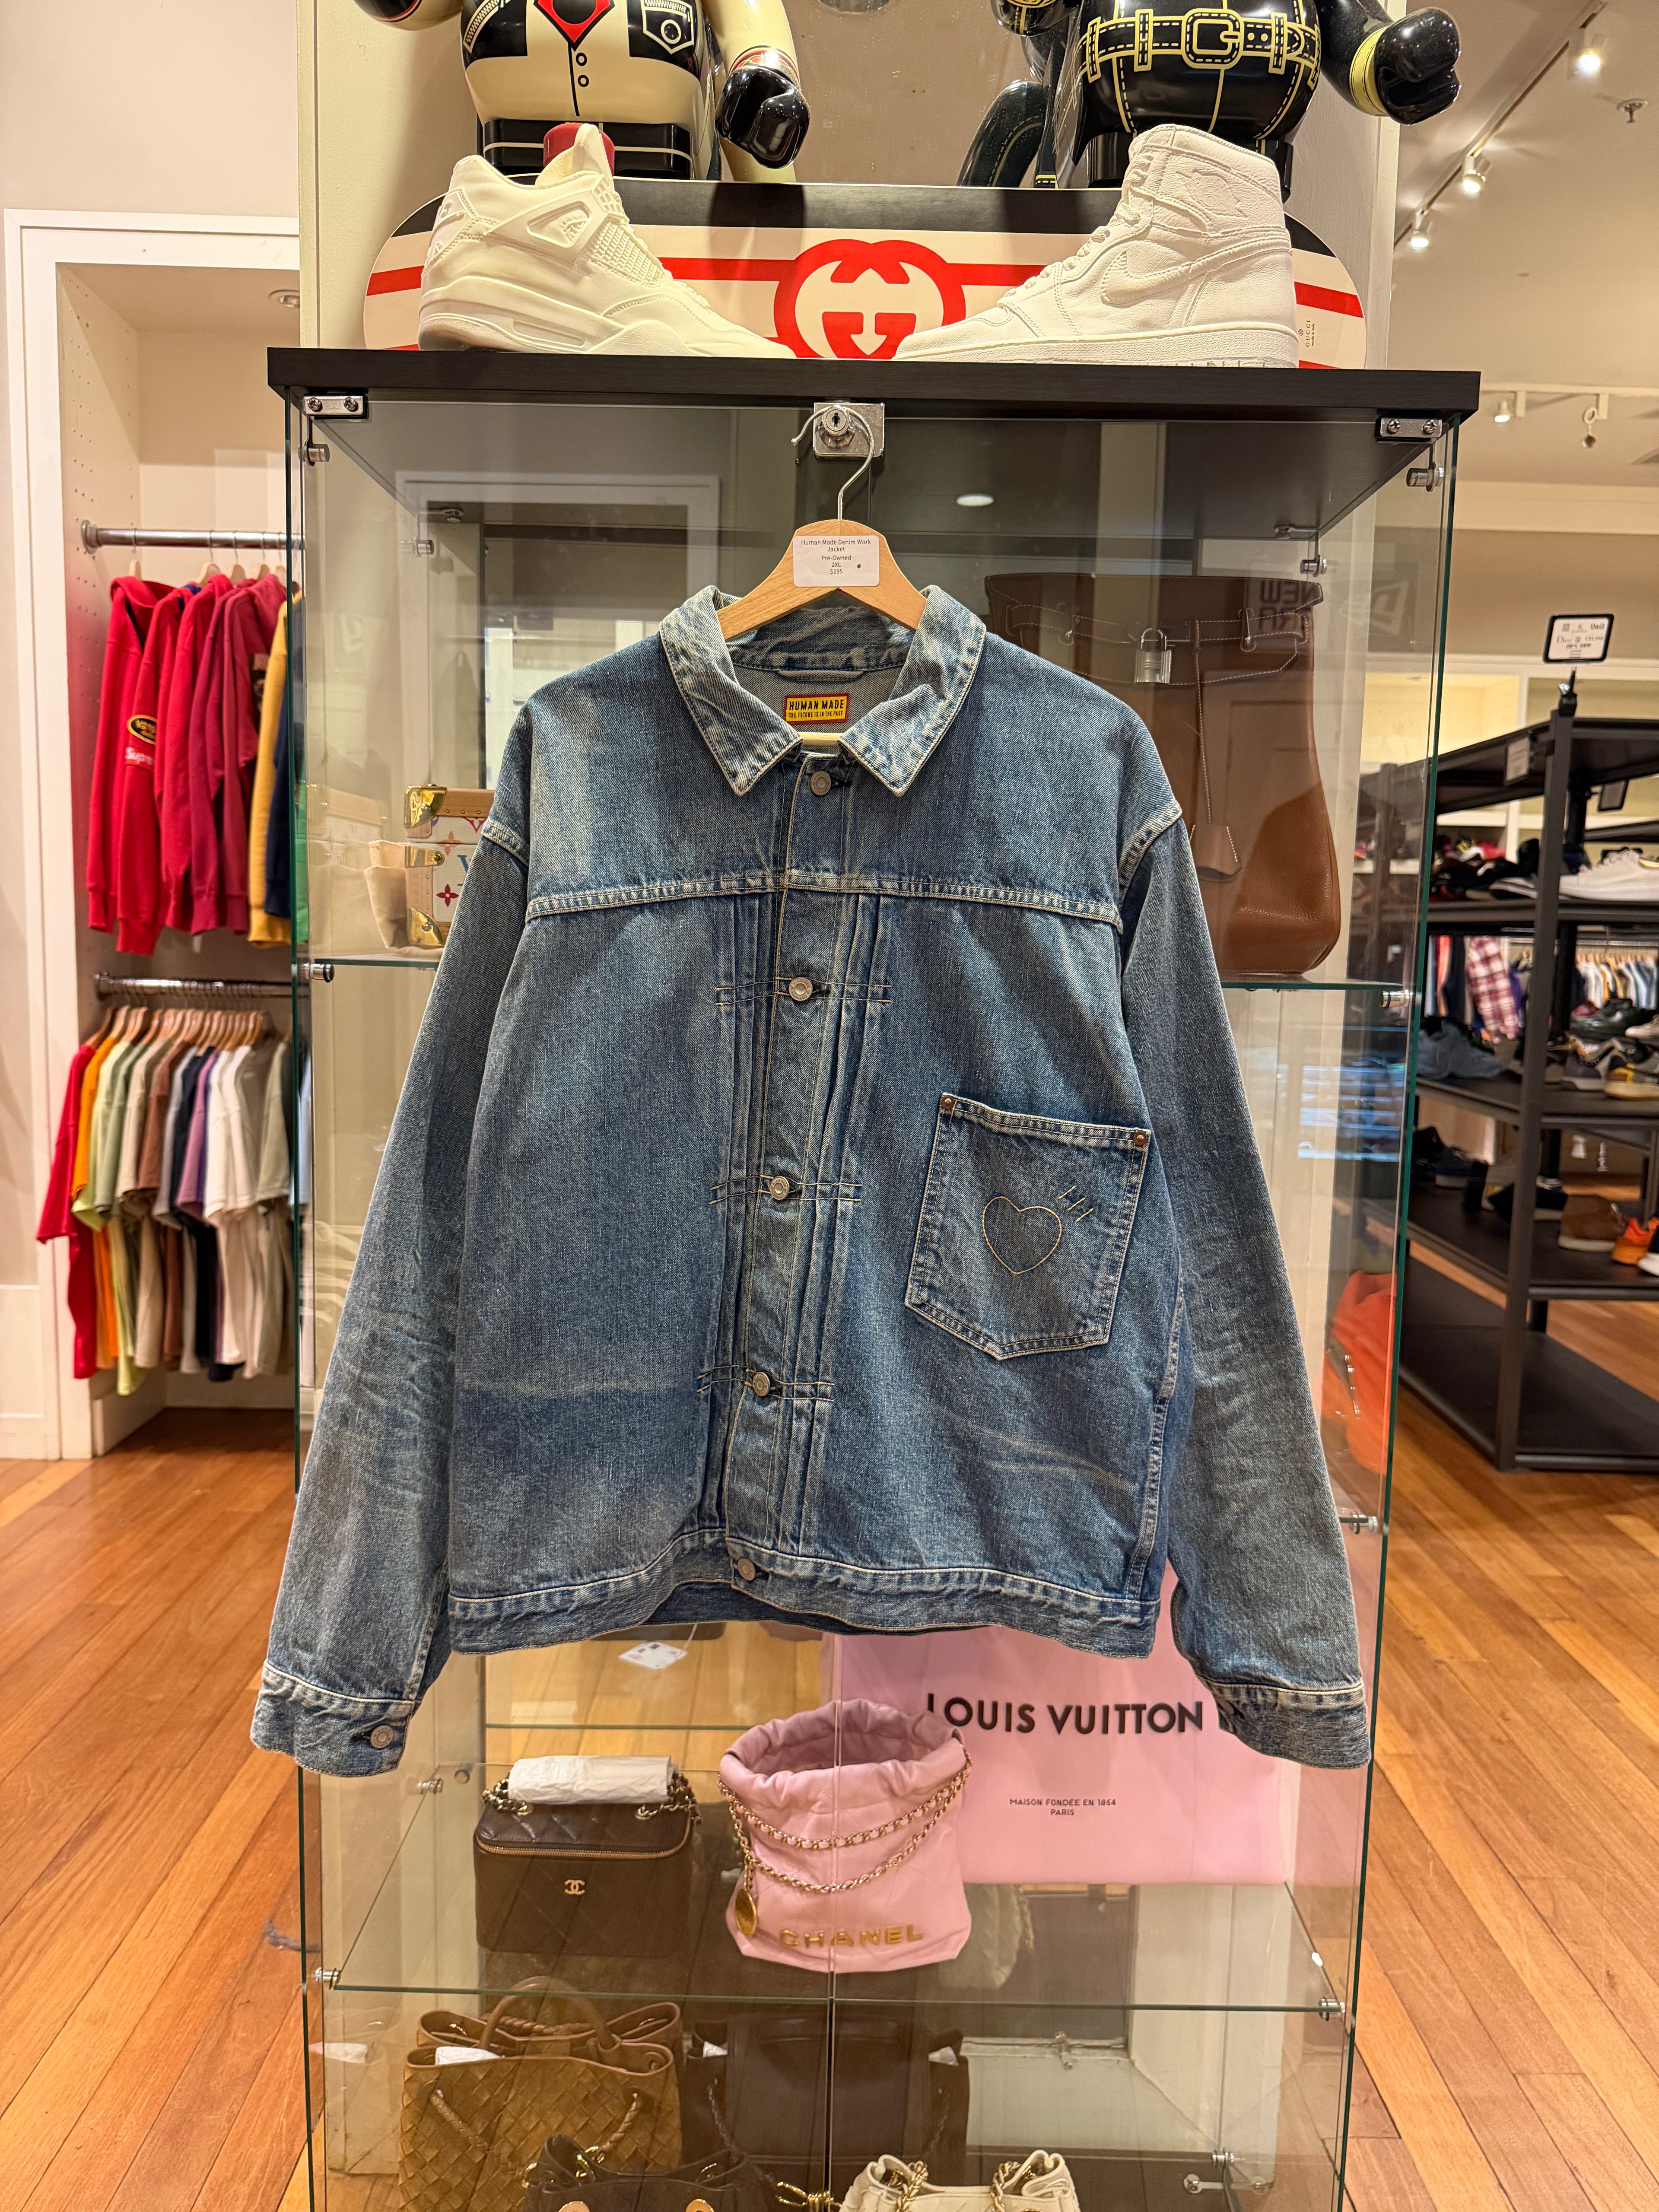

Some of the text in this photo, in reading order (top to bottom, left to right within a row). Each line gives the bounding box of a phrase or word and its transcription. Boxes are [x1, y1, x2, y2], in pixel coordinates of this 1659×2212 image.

[789, 699, 844, 711] HUMAN MADE
[1047, 1700, 1203, 1735] VUITTON
[1046, 1798, 1080, 1806] FONDÉE
[779, 1924, 924, 1947] CHANEL
